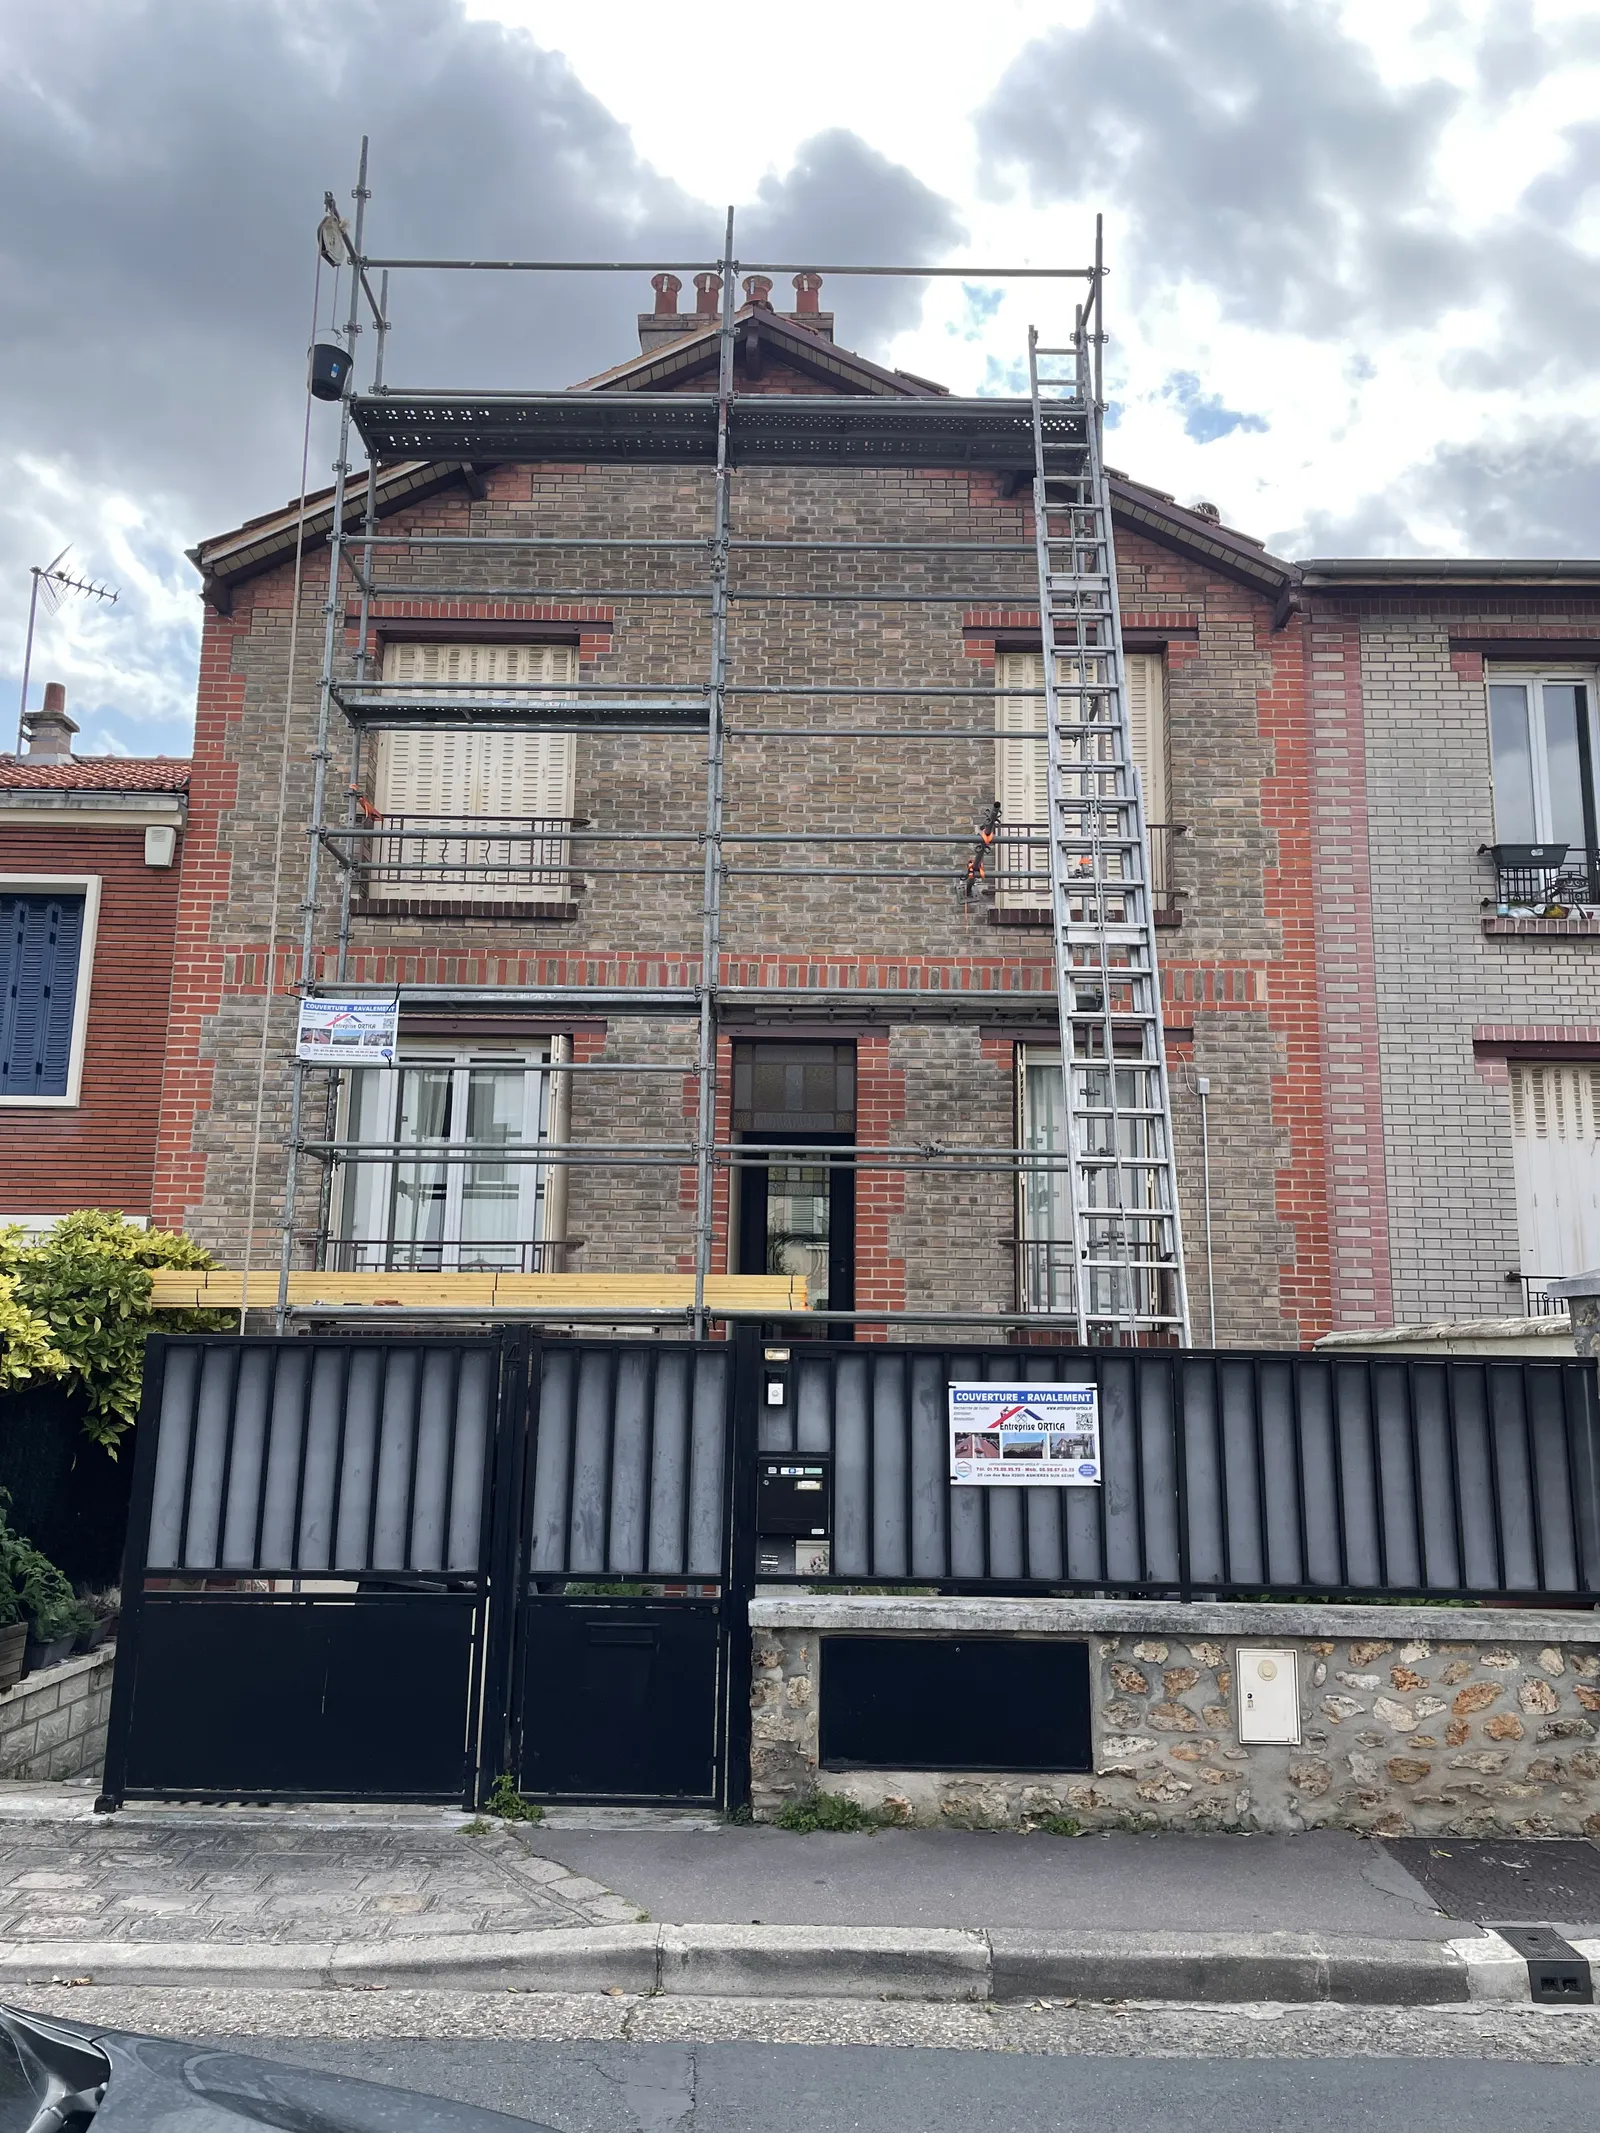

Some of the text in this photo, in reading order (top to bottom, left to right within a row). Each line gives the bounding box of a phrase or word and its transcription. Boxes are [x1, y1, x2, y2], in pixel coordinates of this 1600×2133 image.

[305, 1003, 348, 1011] COUVERTURE
[956, 1392, 1018, 1402] COUVERTURE
[1027, 1393, 1091, 1403] RAVALEMENT
[999, 1422, 1065, 1432] Entreprise ORTICA
